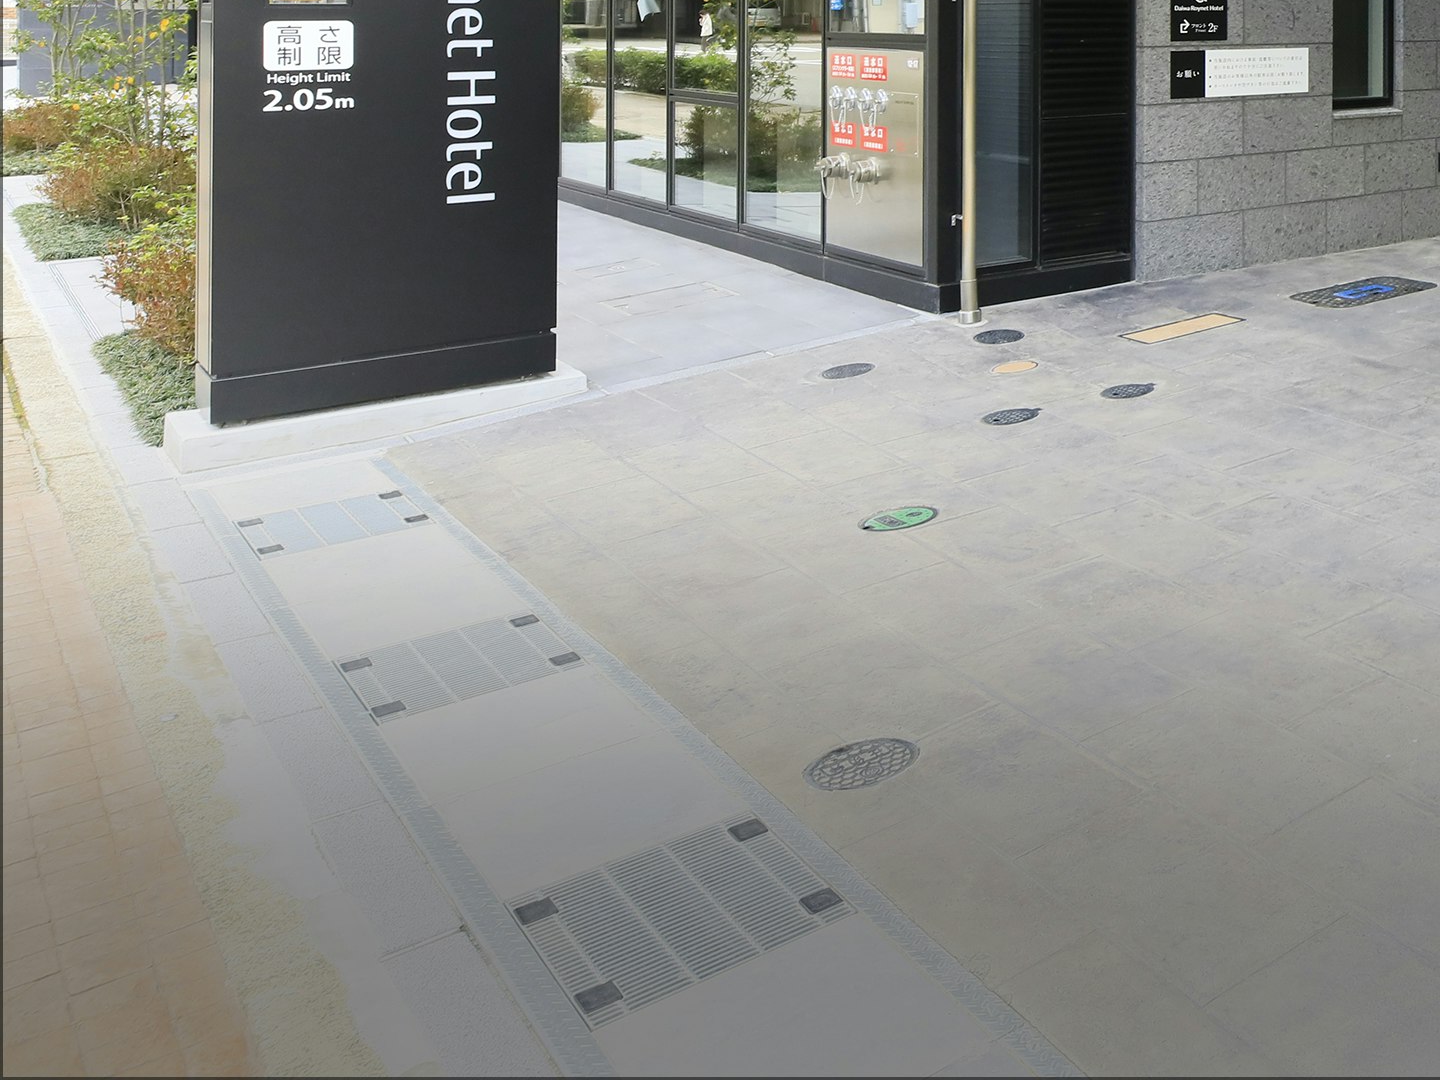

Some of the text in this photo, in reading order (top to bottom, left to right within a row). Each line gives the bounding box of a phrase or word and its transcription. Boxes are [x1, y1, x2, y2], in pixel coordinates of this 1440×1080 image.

[1207, 22, 1219, 33] 2F
[266, 72, 351, 86] Height Limit
[262, 88, 355, 112] 2.05m
[446, 70, 496, 205] Hotel
